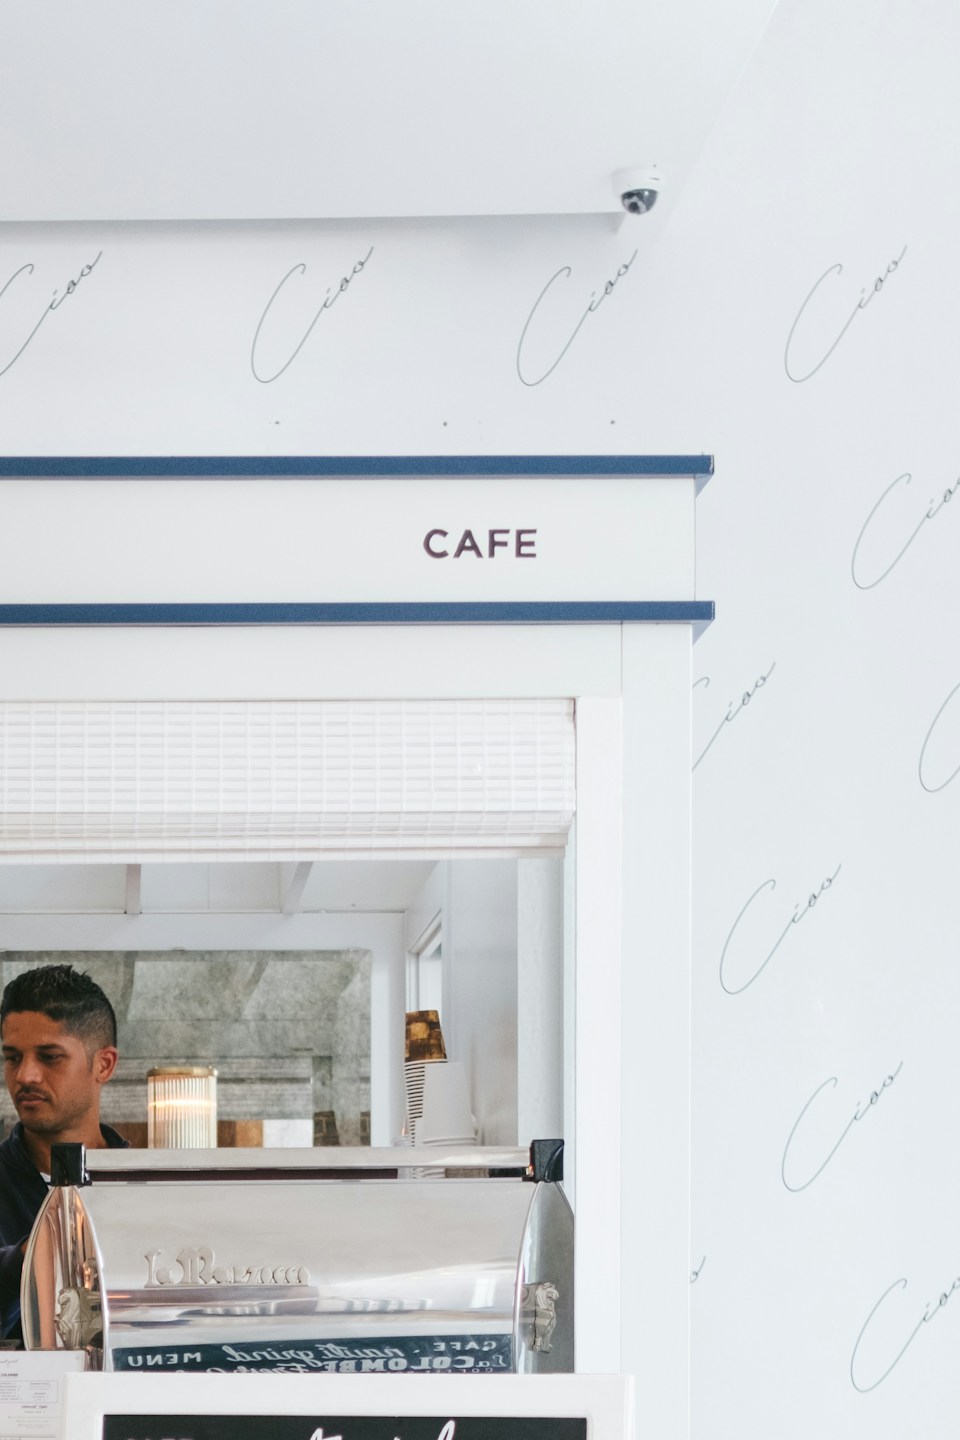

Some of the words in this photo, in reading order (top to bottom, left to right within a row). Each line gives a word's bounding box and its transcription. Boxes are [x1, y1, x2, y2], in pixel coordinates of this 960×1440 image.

[251, 246, 374, 384] Ciao
[517, 249, 637, 386] Ciao
[784, 245, 907, 382] Ciao
[423, 528, 537, 559] CAFE
[851, 473, 960, 590] Cia
[720, 863, 842, 994] Ciao
[781, 1061, 904, 1192] Ciao
